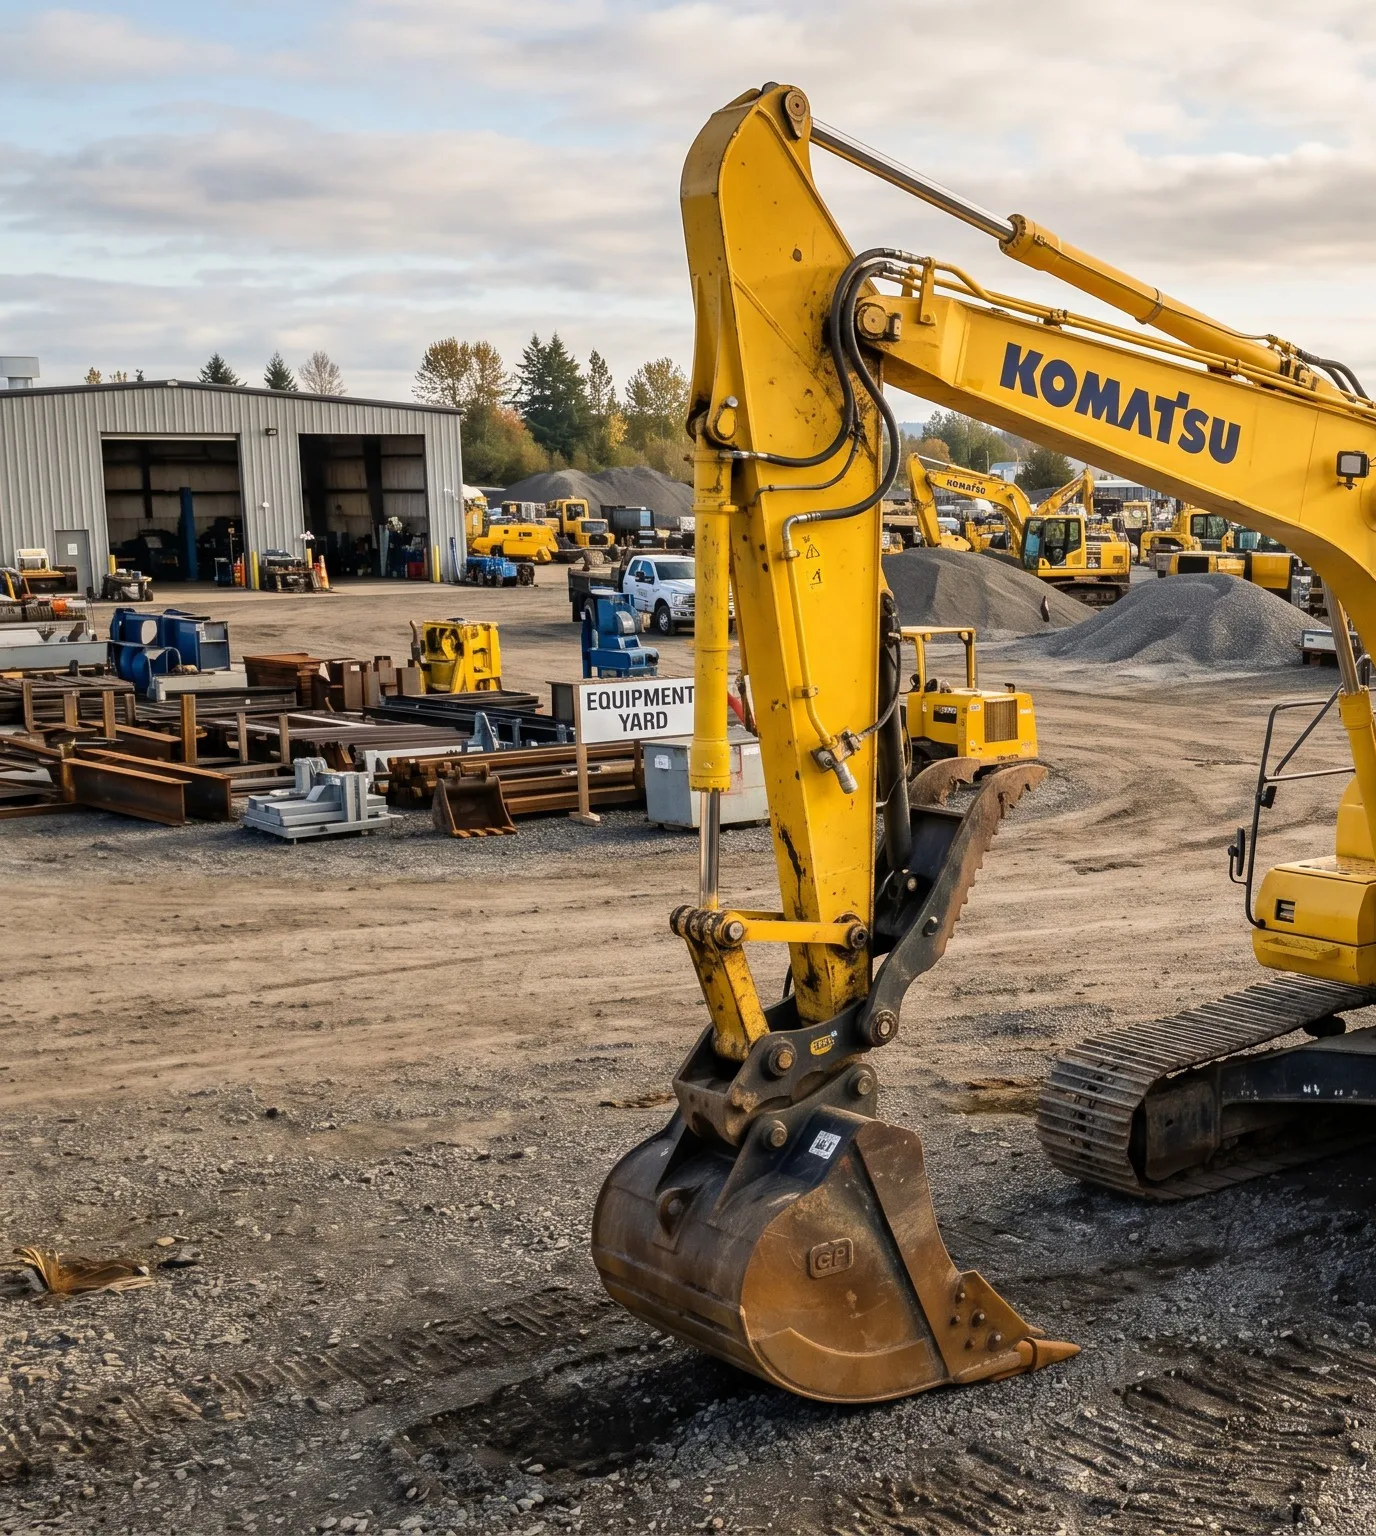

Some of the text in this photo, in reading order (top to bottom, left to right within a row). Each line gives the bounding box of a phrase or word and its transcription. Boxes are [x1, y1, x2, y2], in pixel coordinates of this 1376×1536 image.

[1000, 342, 1241, 464] KOMATSU
[587, 686, 695, 711] EQUIPMENT
[618, 711, 668, 732] YARD
